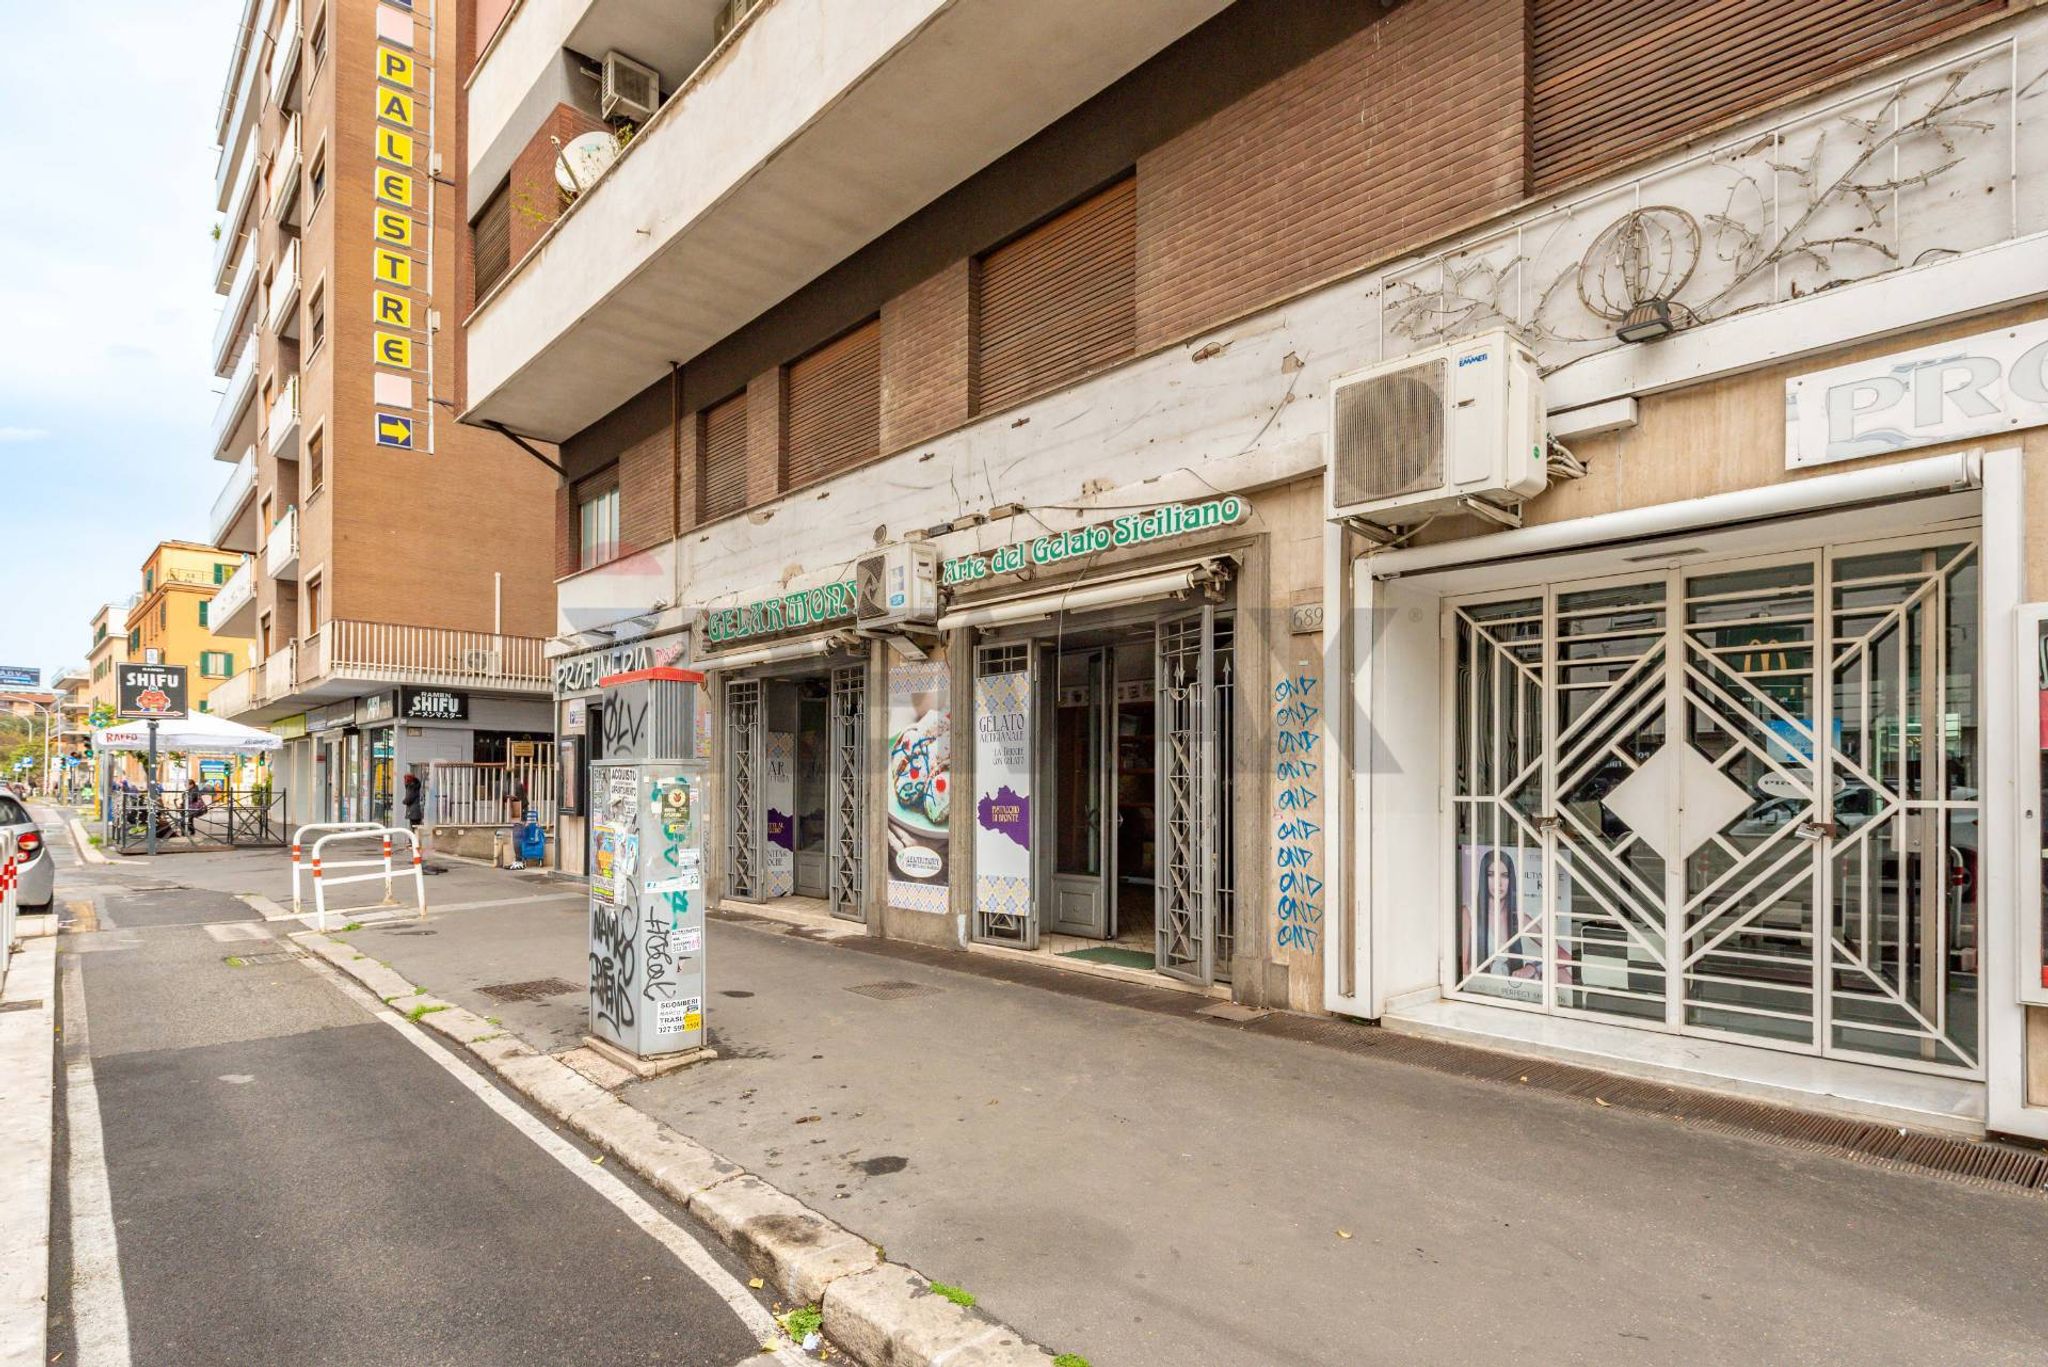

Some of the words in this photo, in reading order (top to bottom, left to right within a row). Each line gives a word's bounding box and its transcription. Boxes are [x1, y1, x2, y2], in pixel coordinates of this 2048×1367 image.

[383, 55, 408, 363] PALESTRE
[943, 555, 985, 585] Arte
[992, 542, 1025, 573] del
[1032, 525, 1110, 565] Gelato
[1114, 497, 1241, 546] Siciliano
[1293, 606, 1323, 628] 689
[126, 671, 179, 688] SHIFU
[556, 647, 650, 693] PROFUMERIA
[412, 696, 459, 712] SHIFU
[979, 714, 1025, 732] GELATO
